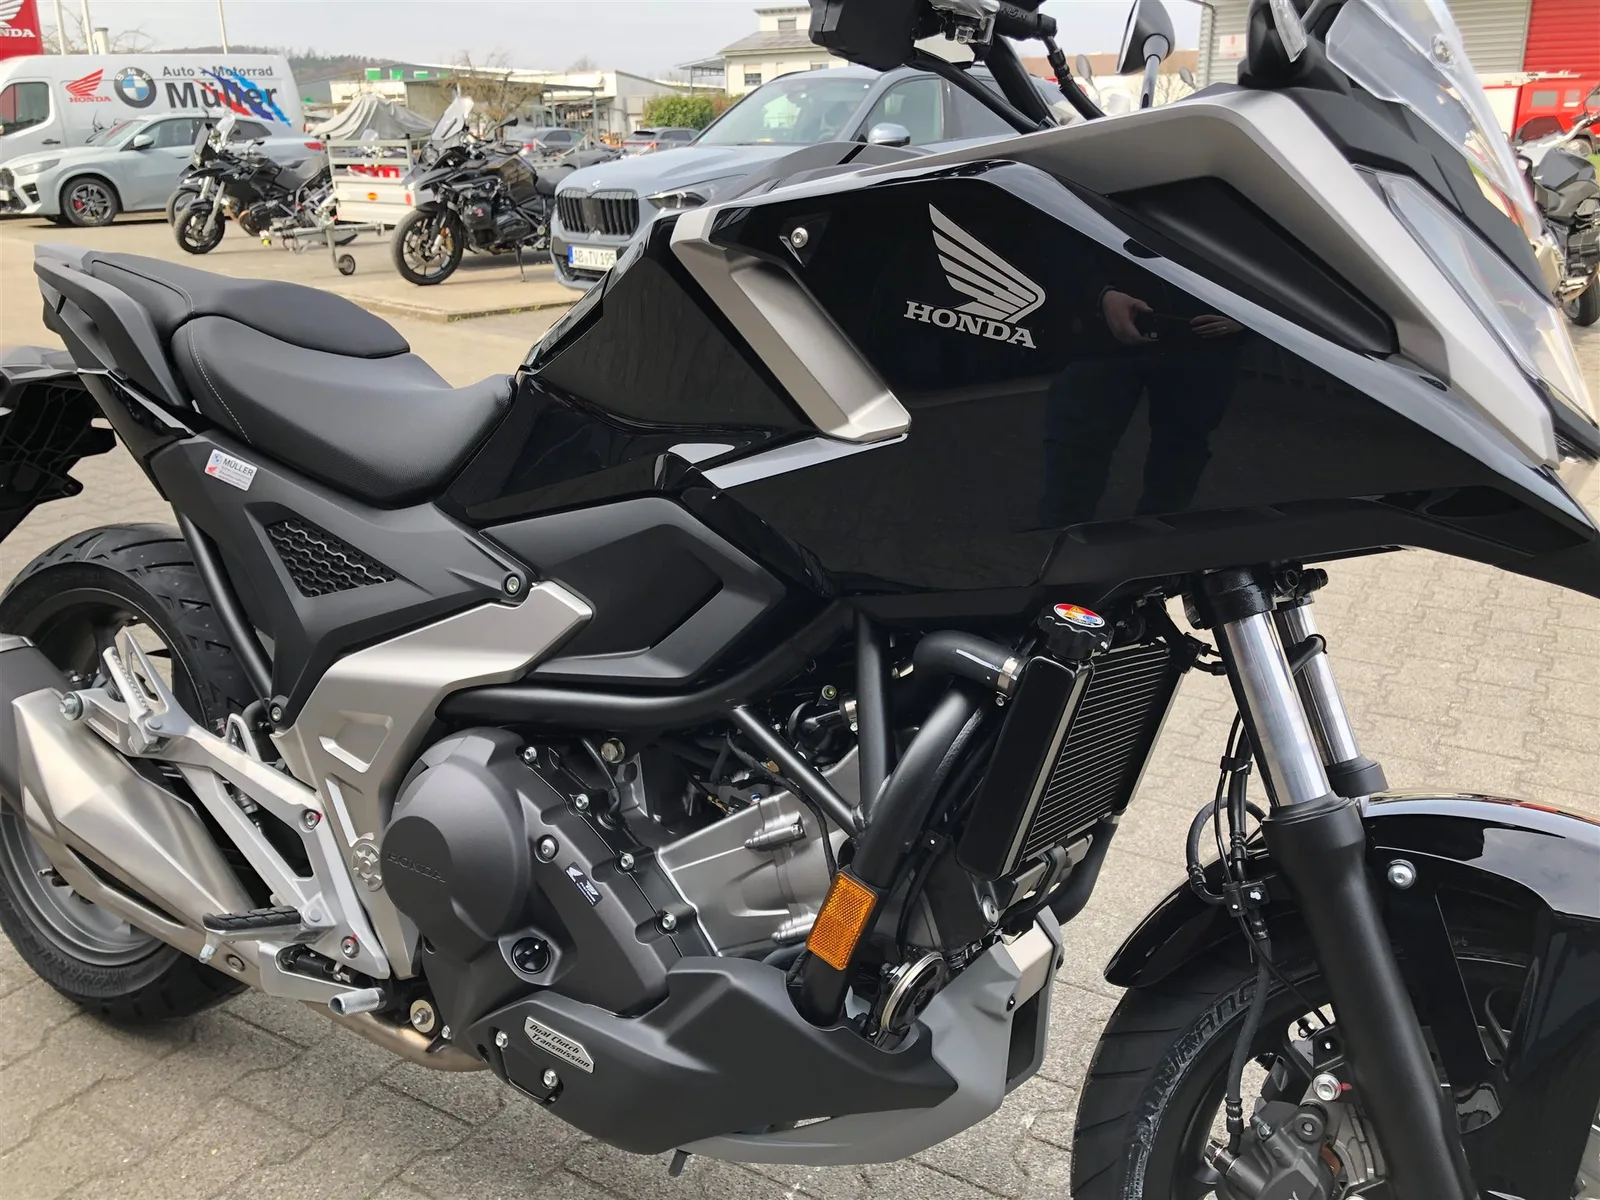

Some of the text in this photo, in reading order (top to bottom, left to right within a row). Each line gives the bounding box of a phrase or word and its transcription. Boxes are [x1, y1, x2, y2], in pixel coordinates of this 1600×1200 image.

[0, 28, 36, 38] NDA
[115, 68, 152, 82] BMW
[163, 66, 195, 77] Auto
[212, 66, 274, 77] Motorrad
[68, 95, 112, 104] HONDA
[165, 81, 278, 109] Müller
[903, 300, 1037, 349] HONDA
[223, 458, 254, 476] MÜLLER
[387, 851, 446, 884] HONDA
[530, 1024, 580, 1054] Dual Clutch
[532, 1033, 590, 1068] Transmission
